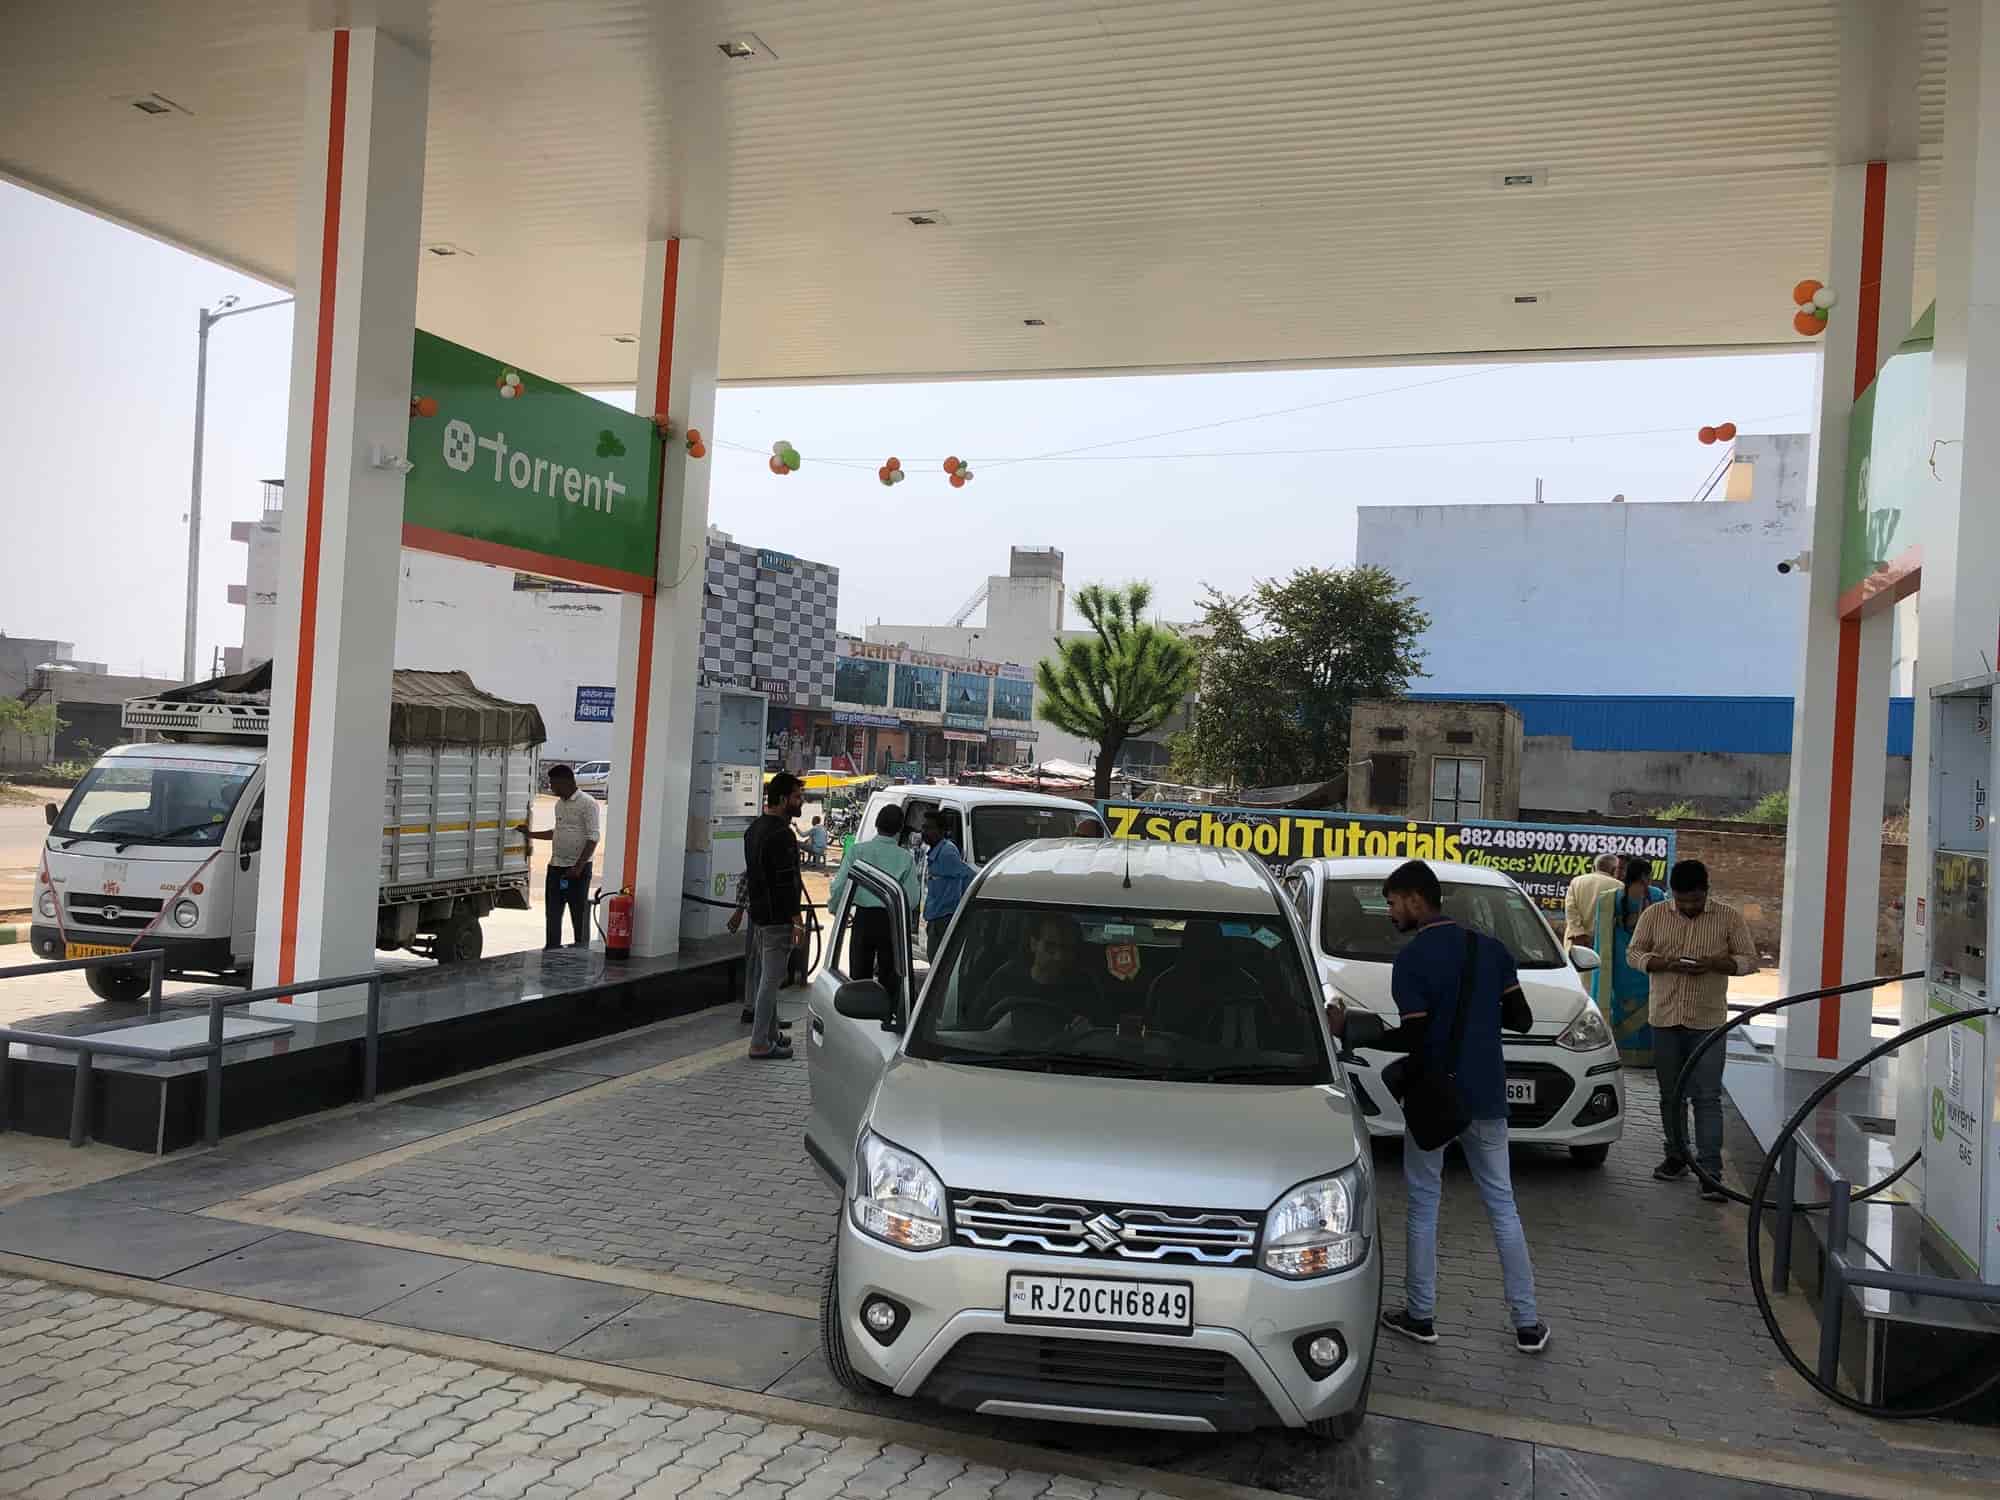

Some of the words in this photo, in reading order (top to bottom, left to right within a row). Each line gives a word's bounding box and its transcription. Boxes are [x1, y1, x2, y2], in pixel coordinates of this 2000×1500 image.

[478, 432, 626, 514] torrent
[1295, 819, 1462, 864] Tutorials
[1031, 1284, 1187, 1319] RJ20CH6849
